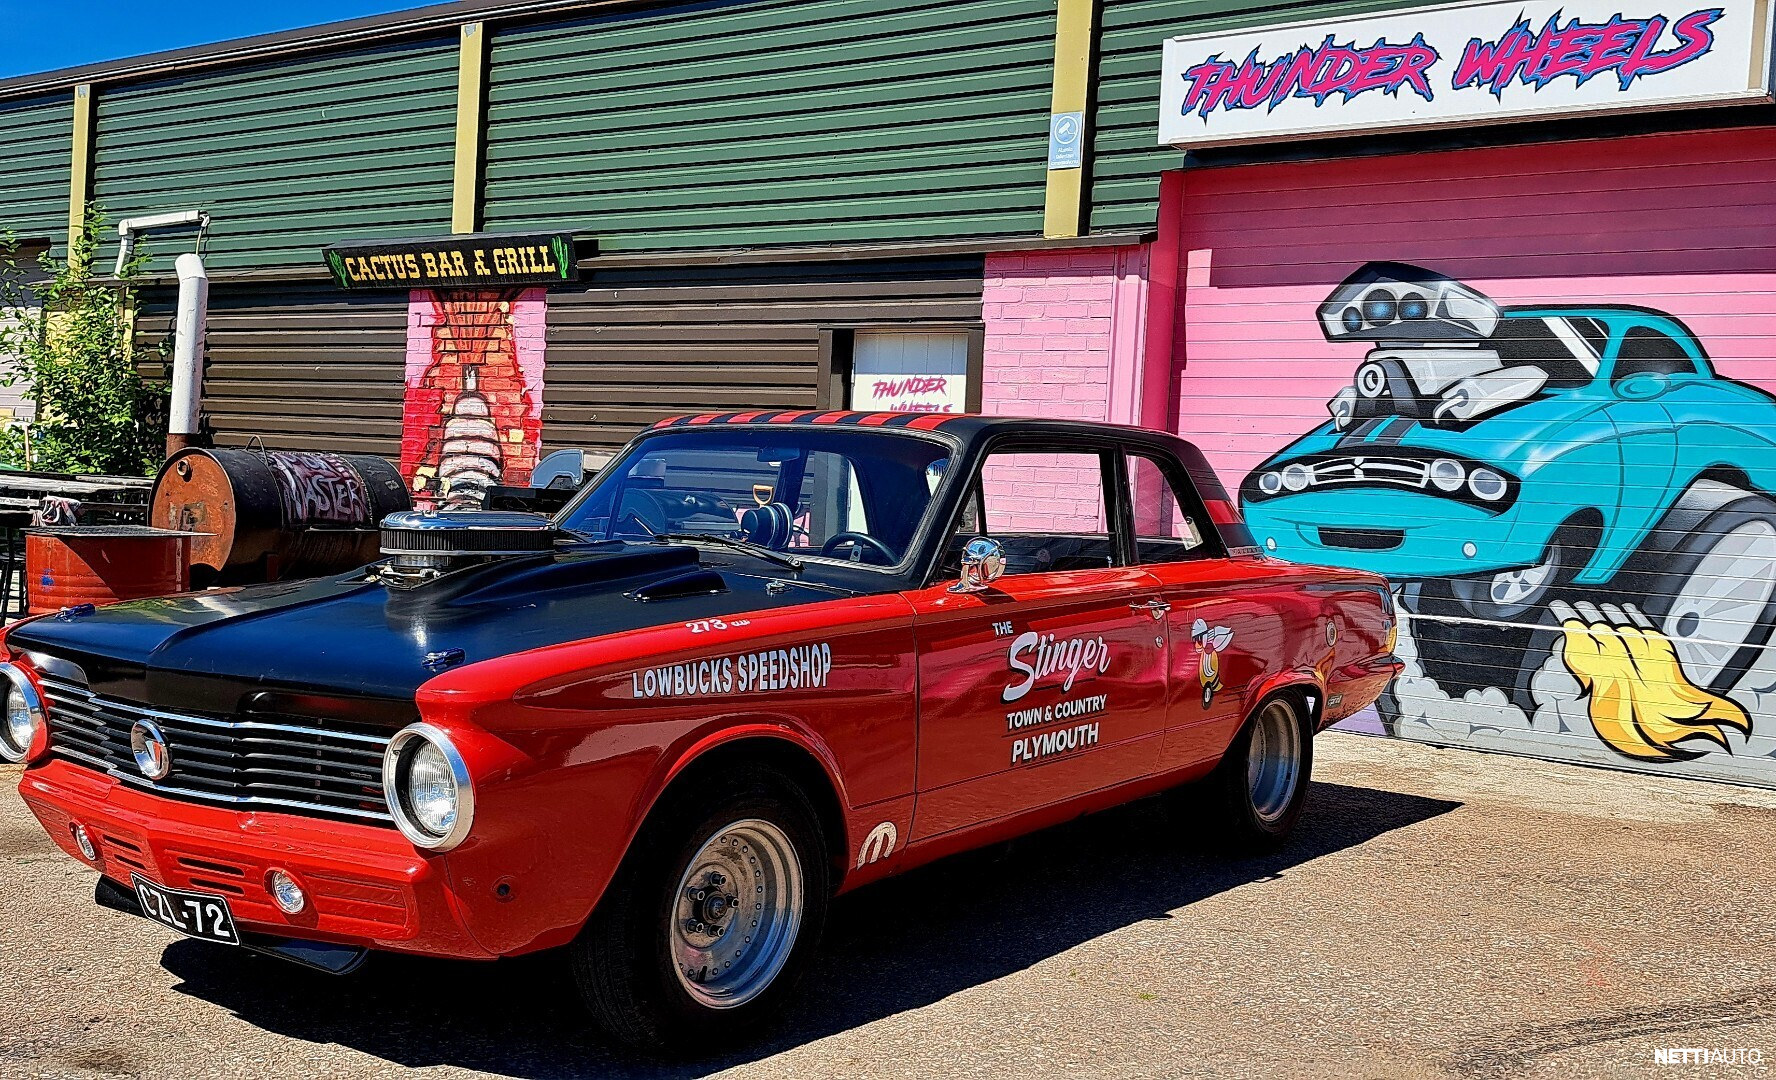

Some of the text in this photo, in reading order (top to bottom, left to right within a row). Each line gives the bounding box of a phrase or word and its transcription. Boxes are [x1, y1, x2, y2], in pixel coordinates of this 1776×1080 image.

[1181, 7, 1724, 124] THUNDER WHEELS
[345, 246, 556, 281] CACTUS BAR & GRILL
[872, 376, 947, 399] THUNDER
[686, 618, 728, 633] 273
[992, 621, 1013, 636] THE
[632, 642, 832, 698] LOWBUCKS SPEEDSHOP
[1002, 631, 1111, 702] Stinger
[1006, 694, 1107, 730] TOWN & COUNTRY
[1011, 721, 1099, 763] PLYMOUTH
[138, 884, 231, 937] CZL-72
